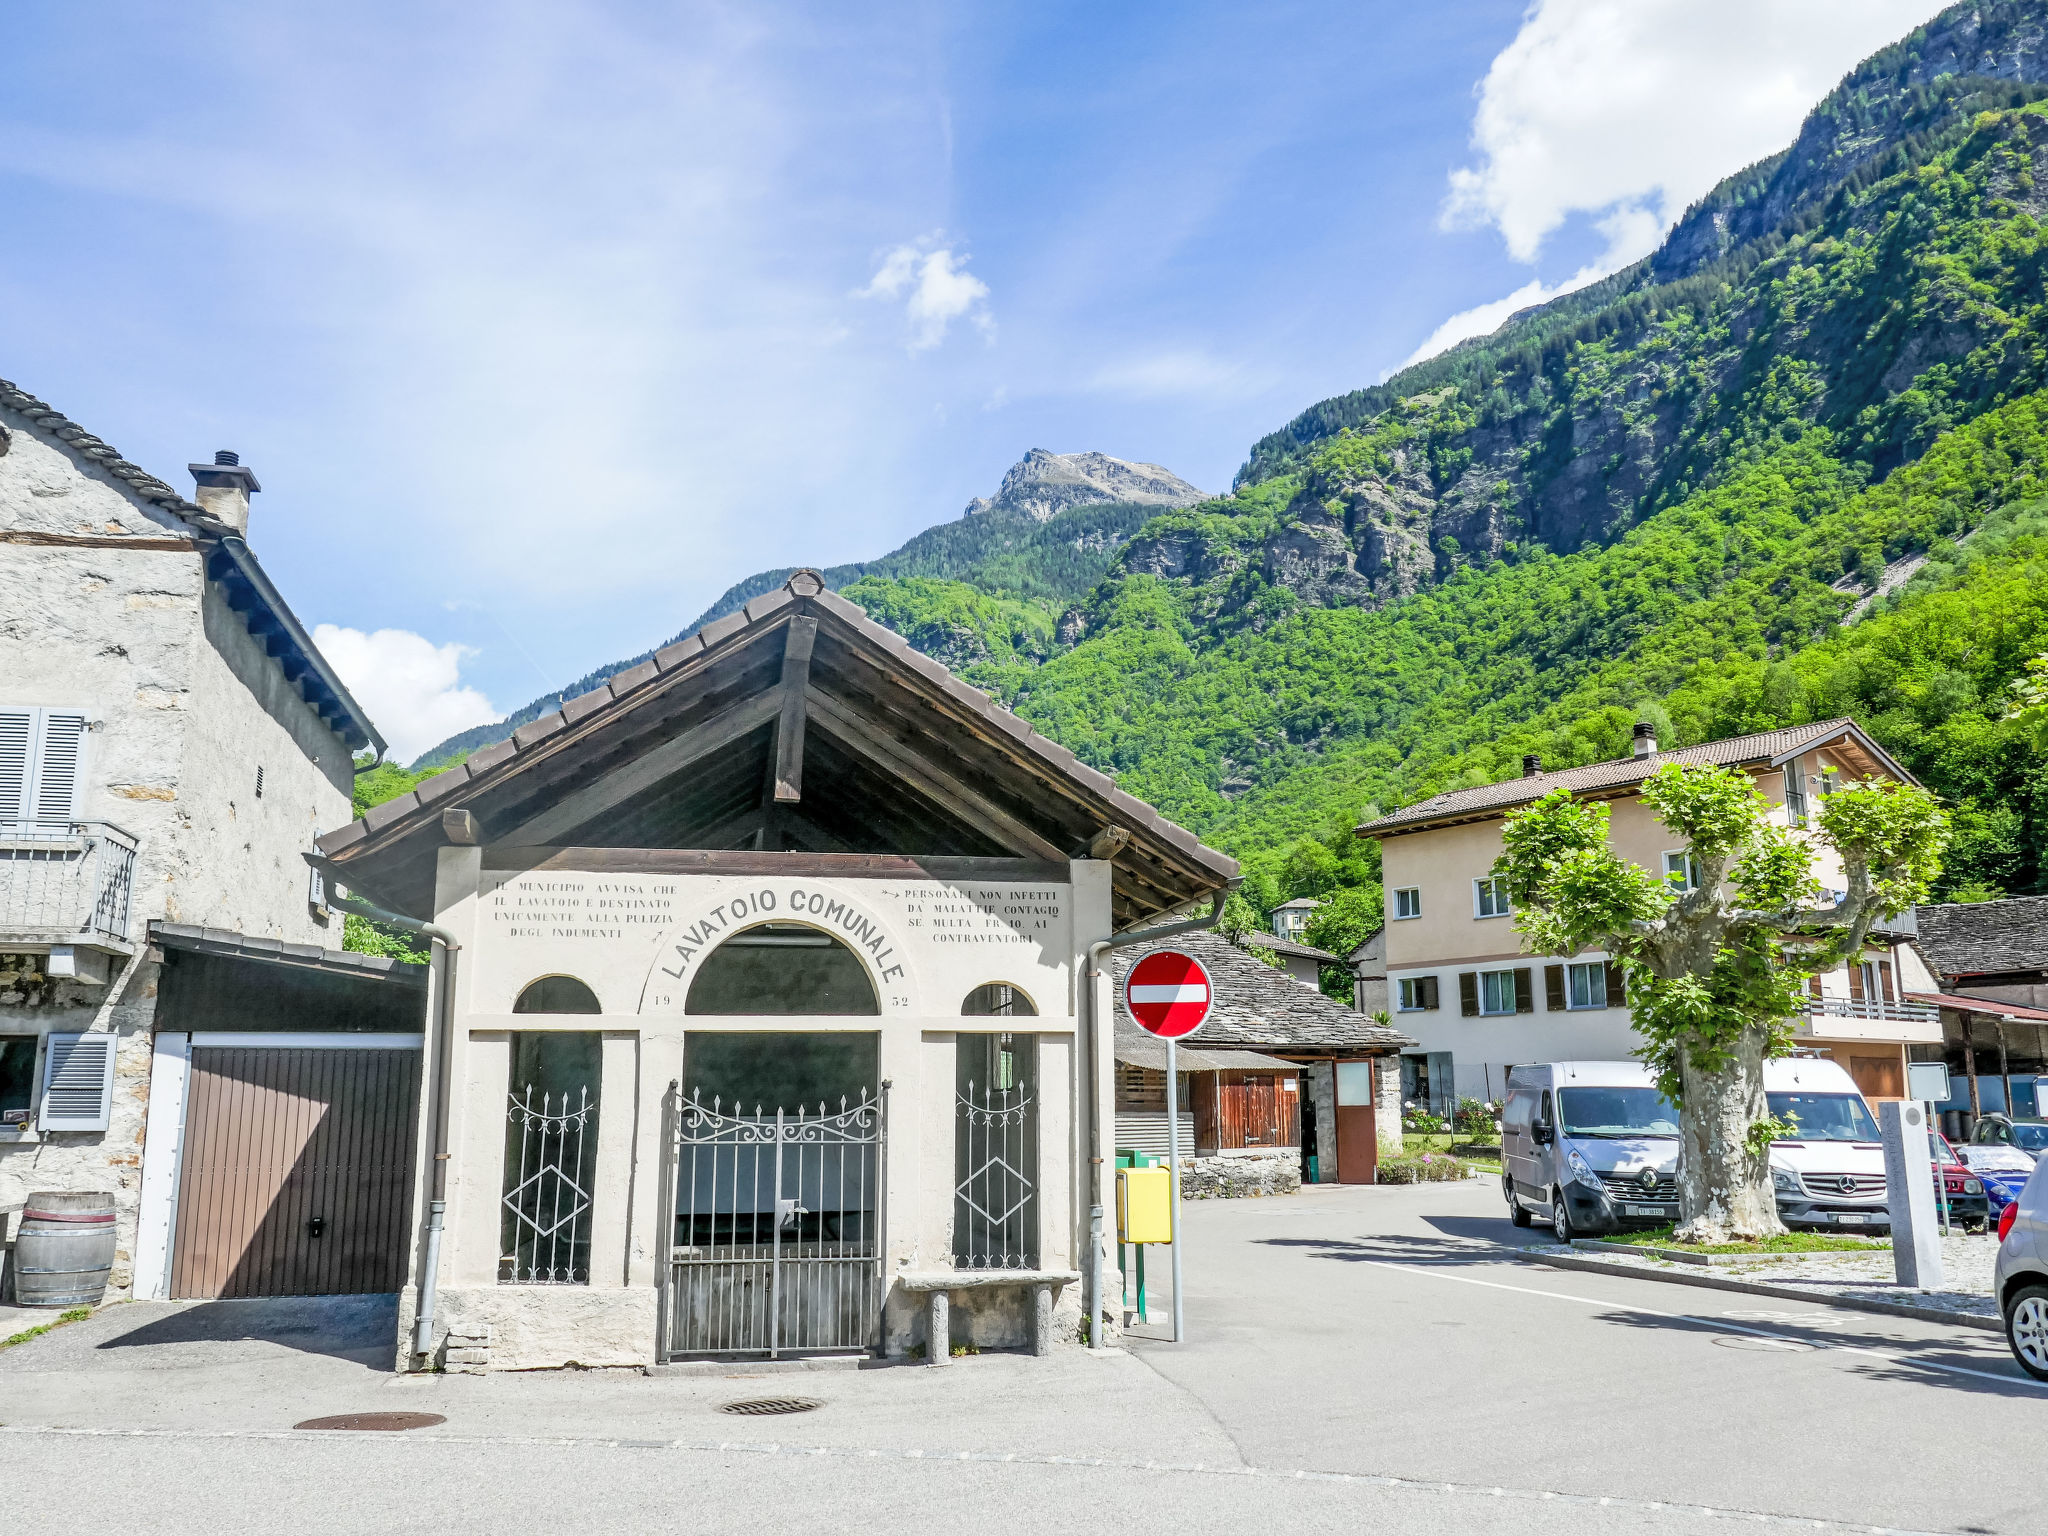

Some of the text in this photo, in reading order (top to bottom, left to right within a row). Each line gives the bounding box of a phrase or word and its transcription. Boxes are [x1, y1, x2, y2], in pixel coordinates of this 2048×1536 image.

[495, 881, 678, 895] IL MUNICIPIO AVVISA CHE
[905, 890, 1057, 900] PERSONALI NON INFETTI
[495, 897, 506, 906] IL
[518, 898, 580, 907] LAVATOIO
[599, 900, 671, 908] DESTINATO
[934, 905, 995, 913] MALATTIE
[494, 912, 673, 923] UNICAMENTE ALLA PULIZIA
[933, 919, 971, 927] MULTA
[1034, 920, 1047, 928] AI
[553, 929, 621, 938] INDUMENTI
[662, 889, 905, 984] LAVATOIO COMUNALE
[933, 934, 1032, 943] CONTRAVENTORI
[655, 996, 670, 1005] 19
